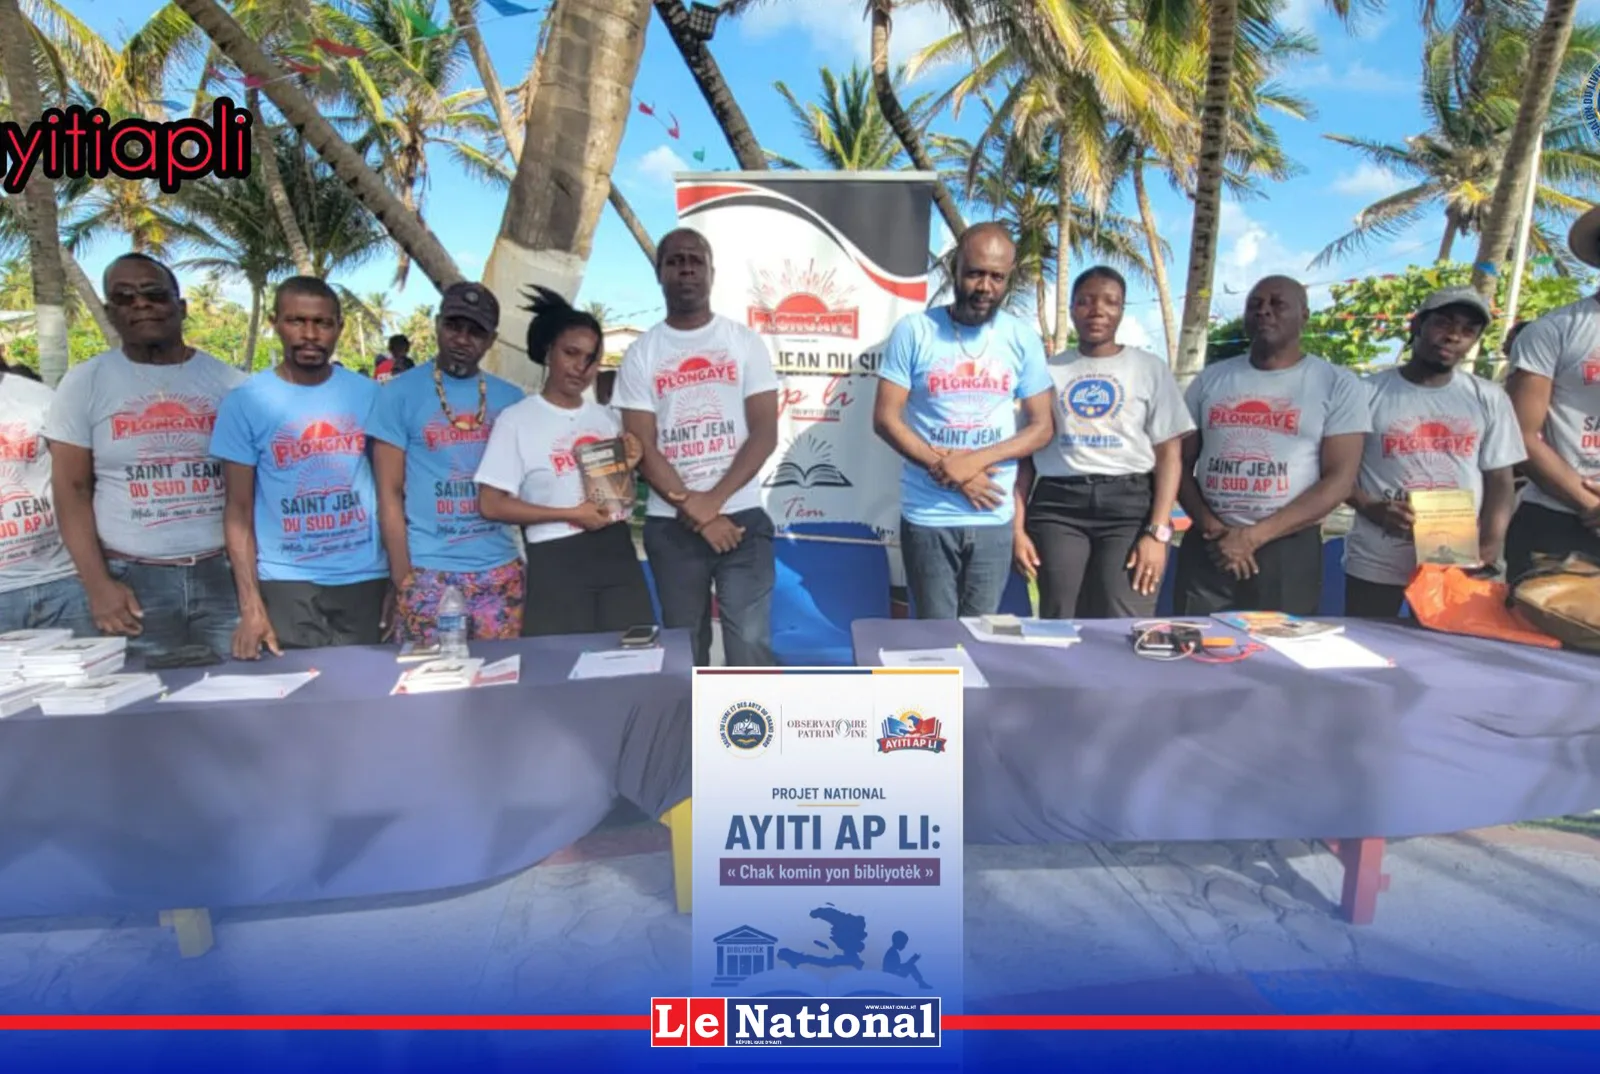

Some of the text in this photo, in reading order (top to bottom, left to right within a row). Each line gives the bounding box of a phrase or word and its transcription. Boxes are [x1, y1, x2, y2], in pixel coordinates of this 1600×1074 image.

[776, 351, 820, 375] JEAN
[859, 352, 884, 377] SU
[655, 363, 737, 396] PLONGAYE
[929, 374, 1011, 396] PLONGAYE
[1209, 408, 1297, 431] PLONGAYE
[662, 420, 735, 443] SAINT JEAN
[930, 427, 1003, 445] SAINT JEAN
[274, 434, 365, 464] PLONGAYE
[681, 441, 705, 457] SUD
[708, 438, 723, 454] AP
[1385, 435, 1476, 456] PLOGAYE
[125, 464, 172, 481] SAINT
[1207, 458, 1288, 477] SAINT JEAN
[129, 481, 149, 498] DU
[152, 480, 186, 496] SUD
[192, 478, 209, 493] AP
[1222, 478, 1248, 491] SUD
[1253, 478, 1273, 494] AP
[1277, 478, 1289, 491] LI
[13, 497, 51, 518] JEAN
[280, 496, 327, 515] SAINT
[437, 500, 454, 514] DU
[0, 519, 18, 538] UD
[24, 515, 42, 534] AP
[283, 517, 301, 532] DU
[306, 514, 335, 531] SUD
